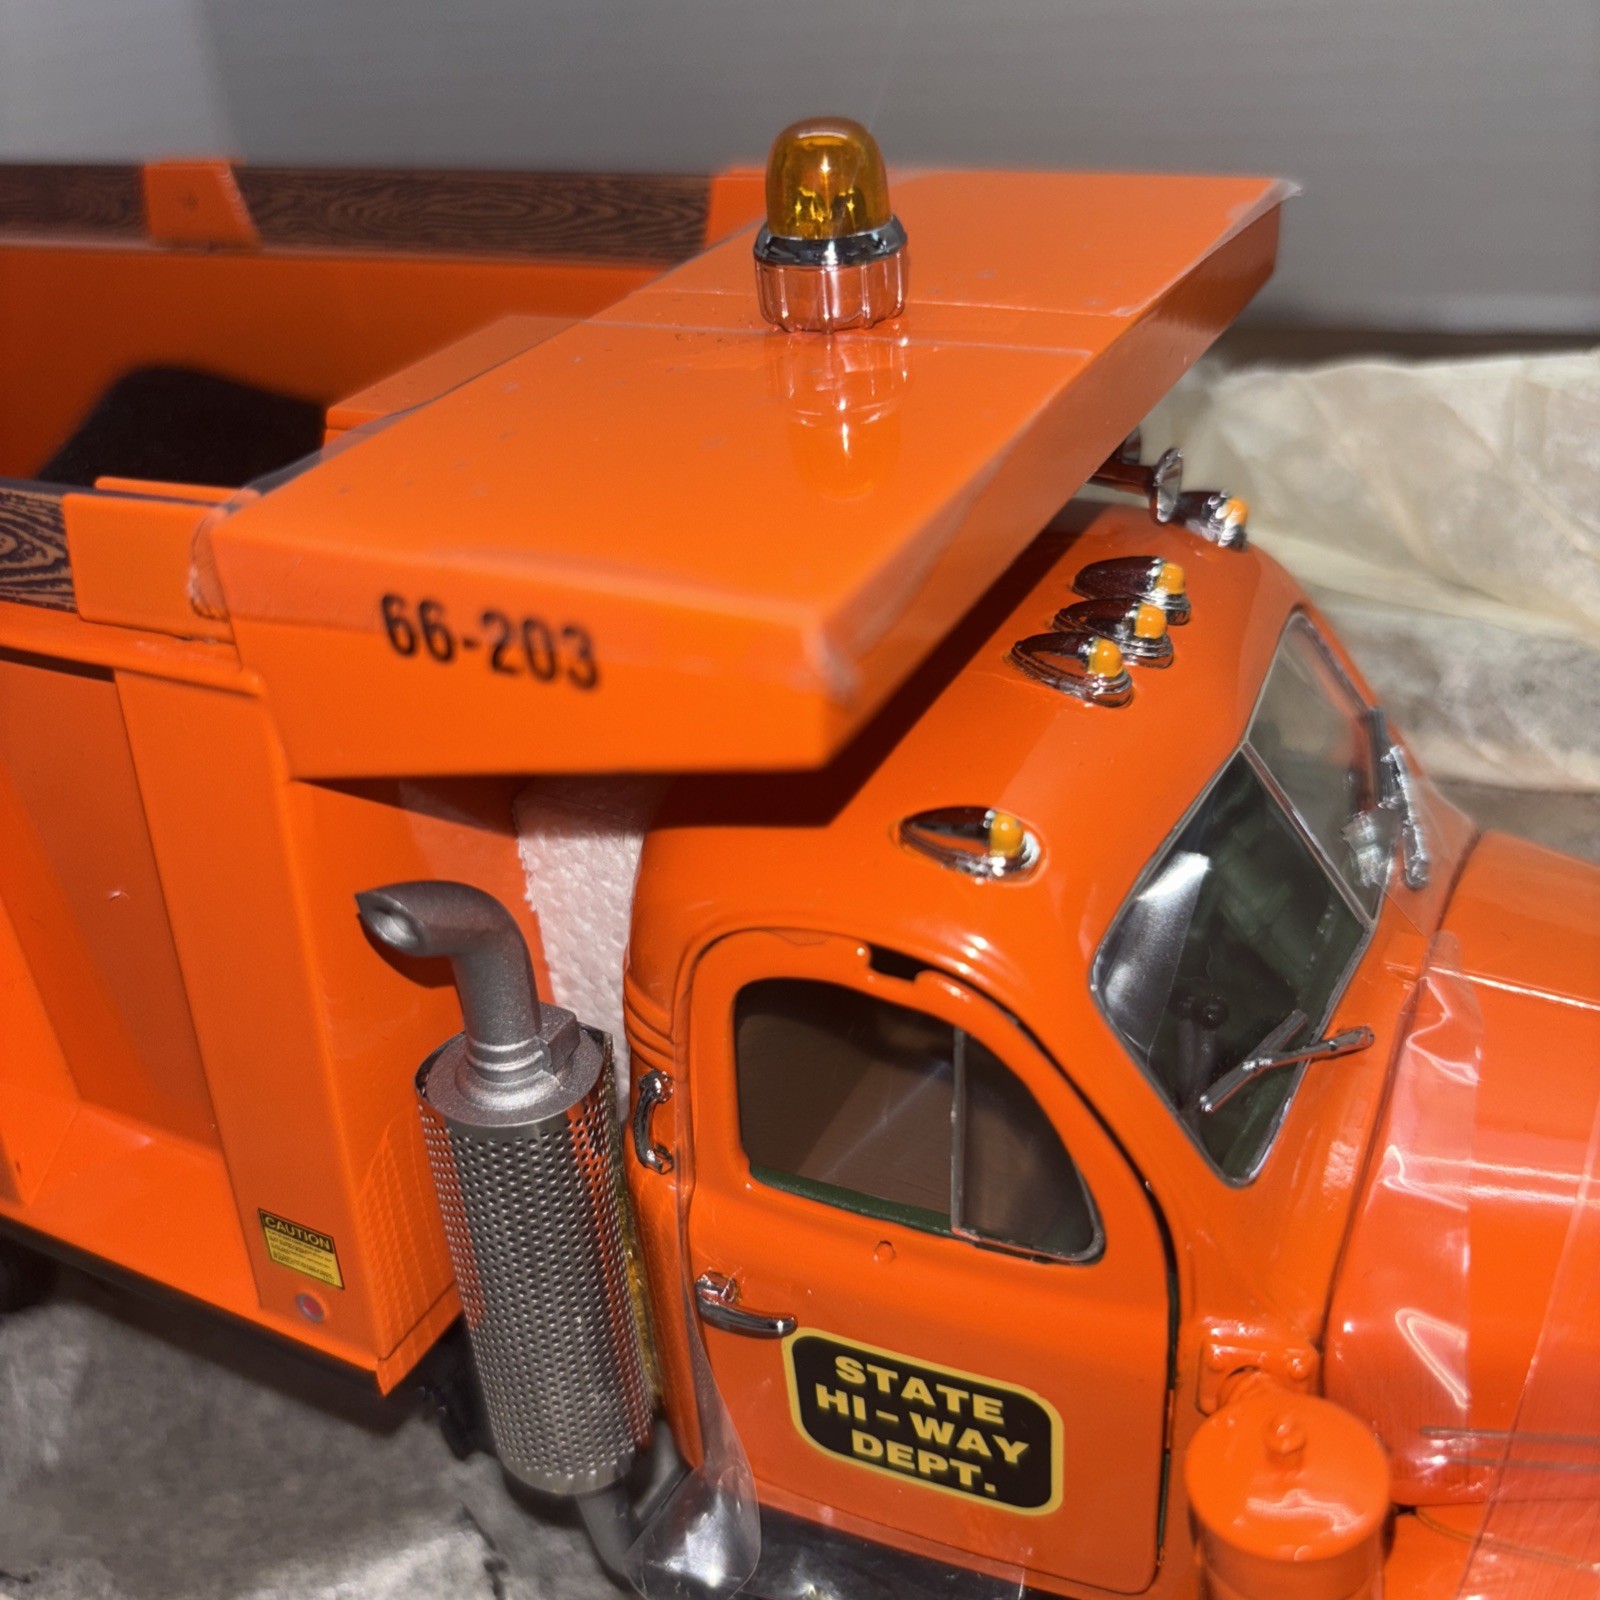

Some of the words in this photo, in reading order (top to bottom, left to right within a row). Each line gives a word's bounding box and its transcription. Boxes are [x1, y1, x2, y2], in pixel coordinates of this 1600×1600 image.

[381, 594, 600, 690] 66-203
[264, 1216, 330, 1250] CAUTION
[834, 1355, 1004, 1425] STATE
[851, 1428, 996, 1492] DEPT.
